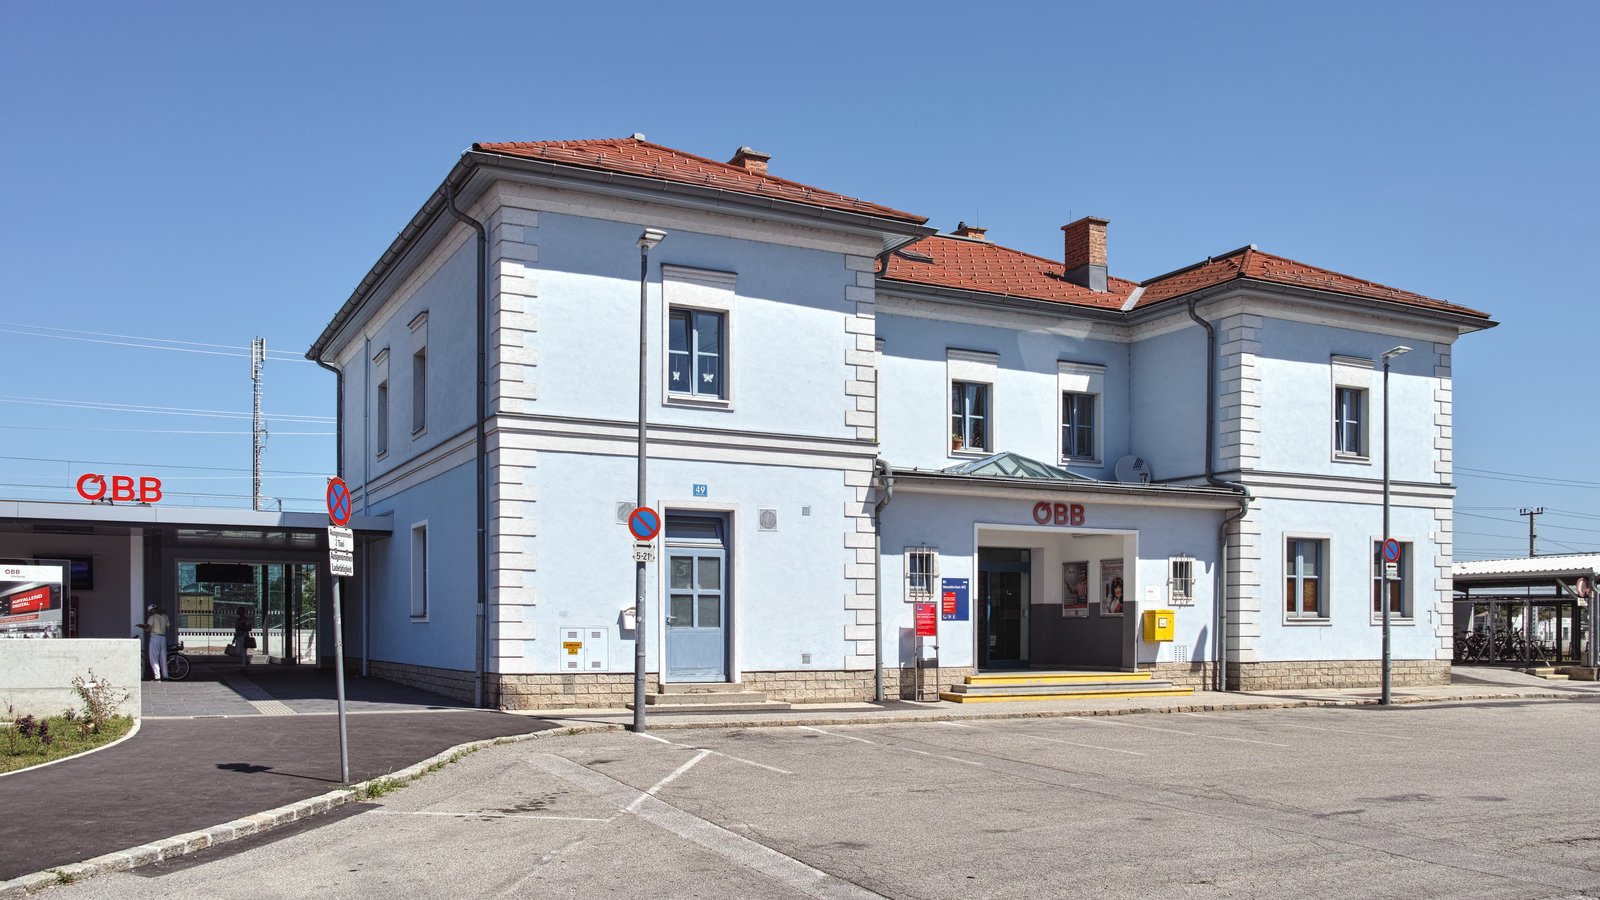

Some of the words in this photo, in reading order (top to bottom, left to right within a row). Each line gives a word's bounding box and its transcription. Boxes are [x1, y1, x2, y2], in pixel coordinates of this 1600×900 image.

[77, 473, 162, 502] ÖBB
[695, 485, 706, 494] 49
[1033, 501, 1086, 526] ÖBB
[330, 551, 353, 562] Ausgenommen
